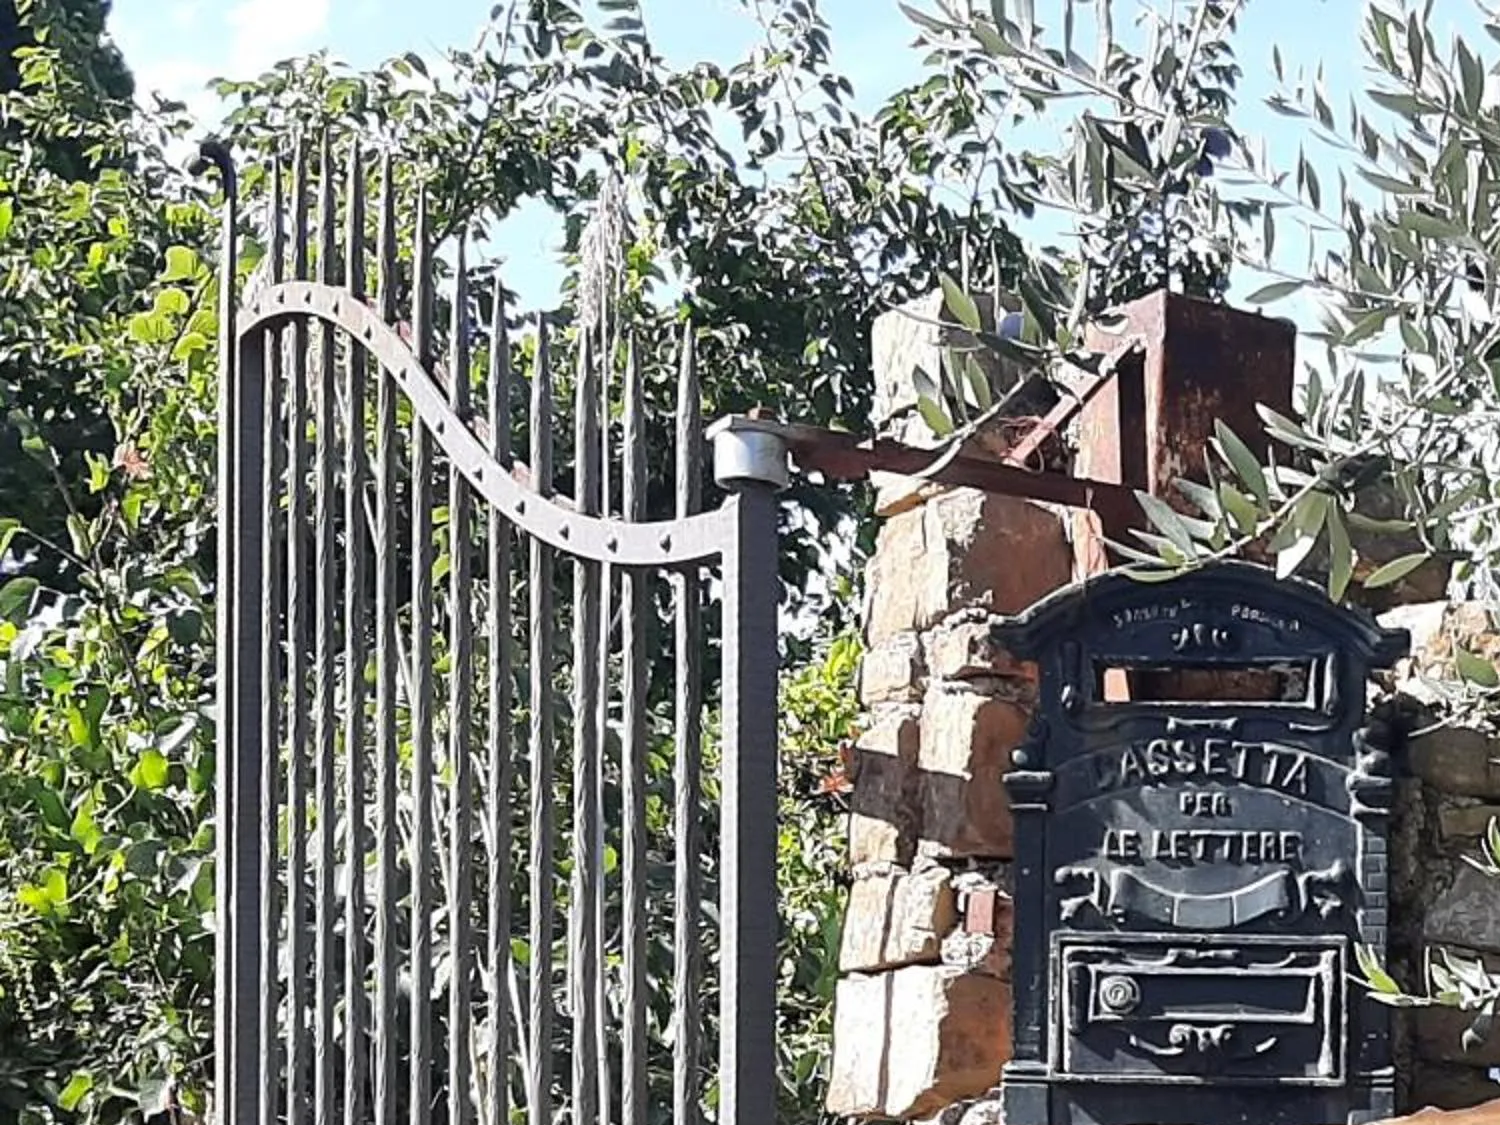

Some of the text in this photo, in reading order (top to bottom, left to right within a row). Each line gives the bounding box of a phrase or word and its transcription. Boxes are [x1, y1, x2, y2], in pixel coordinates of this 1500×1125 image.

[1179, 791, 1232, 818] PER
[1102, 828, 1304, 864] LE LETTERE
